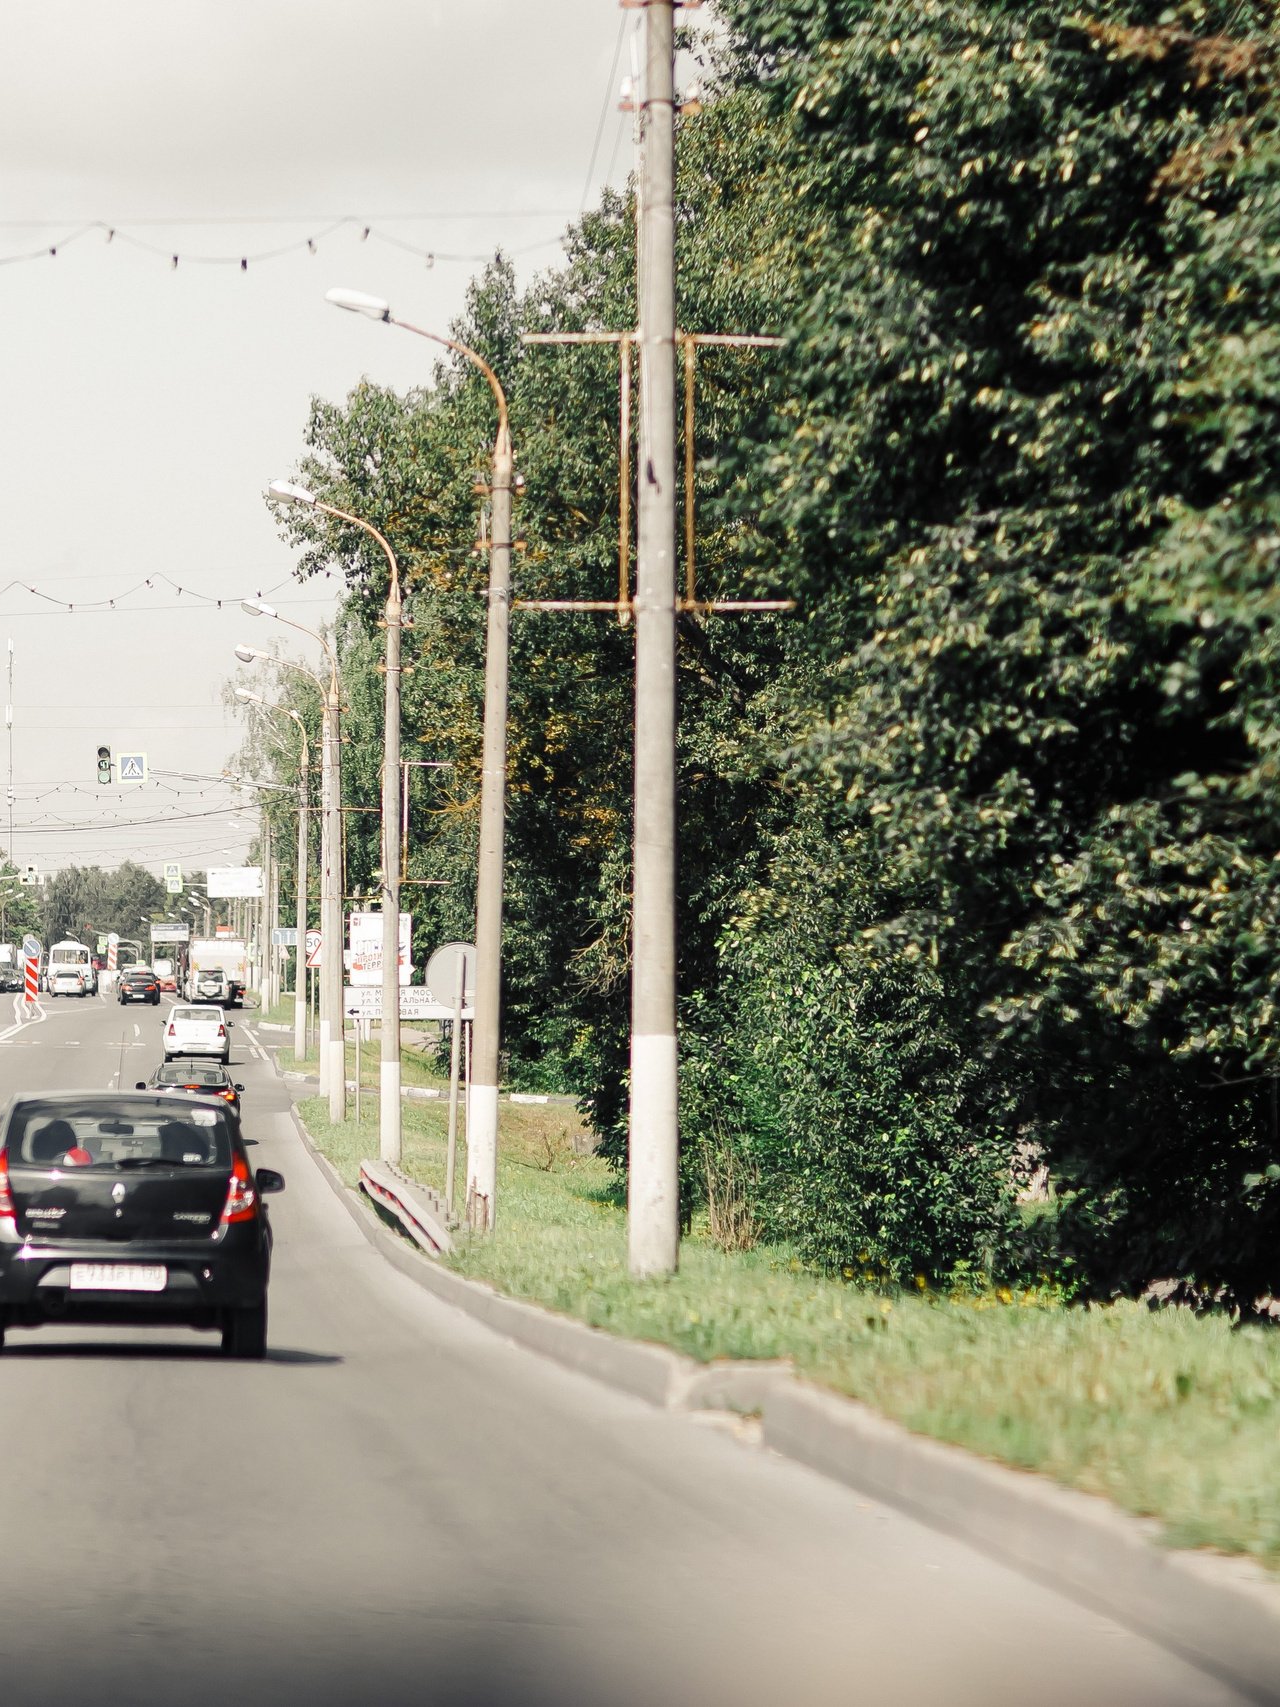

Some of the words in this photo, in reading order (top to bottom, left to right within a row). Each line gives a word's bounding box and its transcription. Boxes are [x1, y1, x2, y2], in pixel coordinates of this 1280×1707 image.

[306, 937, 320, 948] 50
[357, 952, 382, 963] ПРОТИ
[363, 960, 382, 970] ТЕРР
